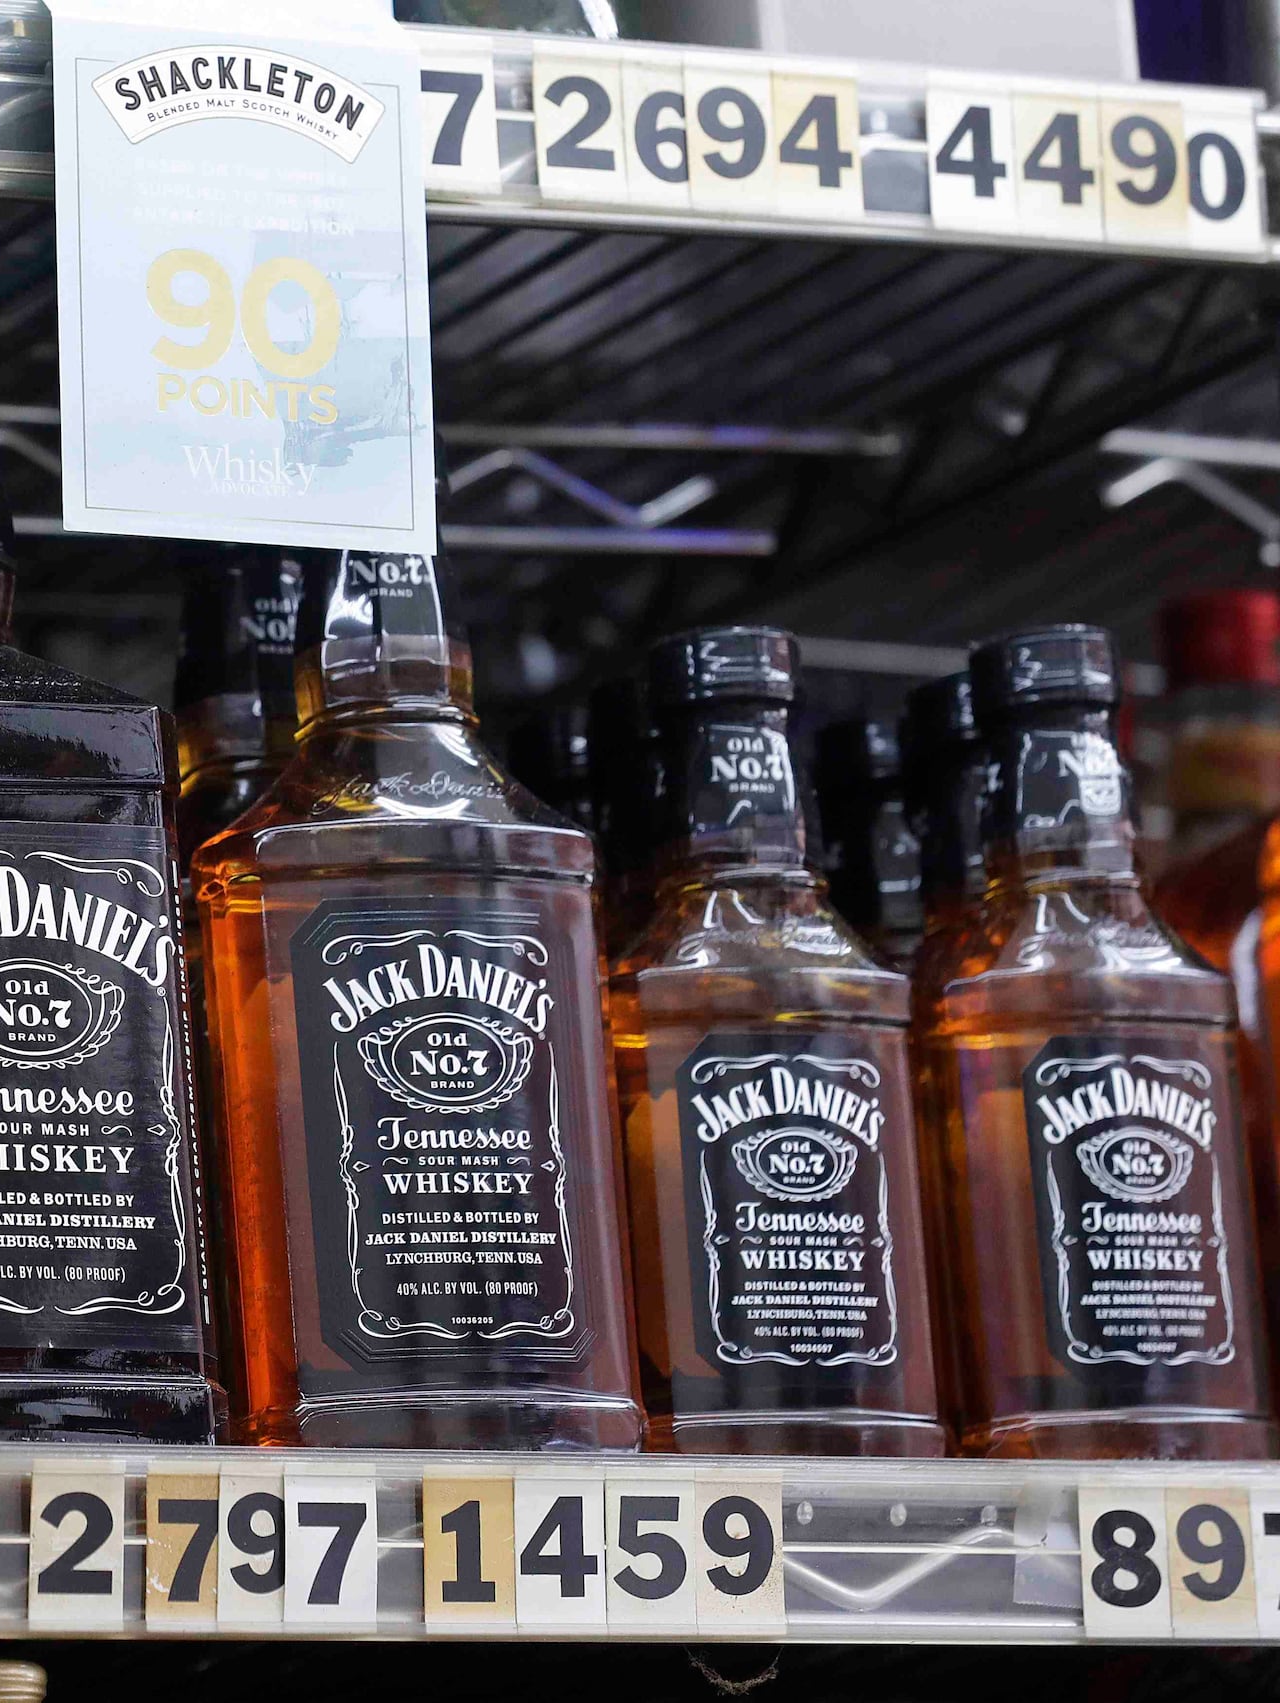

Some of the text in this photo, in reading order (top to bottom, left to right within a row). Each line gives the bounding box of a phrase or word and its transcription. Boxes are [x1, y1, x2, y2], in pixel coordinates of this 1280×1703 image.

[114, 55, 365, 132] SHACKLETON
[545, 73, 853, 189] 2694
[935, 106, 1246, 222] 4490
[145, 246, 342, 379] 90
[157, 373, 339, 425] POINTS
[180, 443, 317, 497] Whisky
[710, 754, 784, 783] No.7
[5, 979, 50, 996] Old
[322, 943, 556, 1033] JACK DANIEL'S
[8, 1032, 57, 1043] BRAND
[427, 1032, 469, 1047] Old
[409, 1049, 490, 1076] No.7
[430, 1080, 475, 1089] BRAND
[690, 1066, 886, 1147] JACK DANIEL'S
[1036, 1067, 1217, 1147] JACK DANIEL'S
[41, 1122, 90, 1137] MASH
[377, 1117, 533, 1150] Tennessee
[780, 1141, 811, 1154] Old
[418, 1156, 499, 1166] SOUR MASH
[768, 1154, 825, 1175] No.7
[1111, 1154, 1165, 1176] No.7
[382, 1172, 534, 1194] WHISKEY
[30, 1193, 41, 1205] &
[43, 1192, 112, 1207] BOTTLED
[116, 1194, 135, 1207] BY
[50, 1214, 156, 1230] DISTILLERY
[382, 1212, 540, 1224] DISTILLED & BOTTLED BY
[735, 1202, 866, 1233] Tennessee
[1081, 1202, 1203, 1234] Tennessee
[106, 1236, 138, 1251] USA
[365, 1232, 557, 1245] JACK DANIEL DISTILLERY
[769, 1236, 838, 1246] SOUR MASH
[740, 1250, 866, 1272] WHISKEY
[1086, 1250, 1204, 1272] WHISKEY
[20, 1265, 35, 1279] BY
[37, 1265, 61, 1280] VOL.
[64, 1265, 83, 1282] (80
[86, 1266, 127, 1283] PROOF)
[396, 1282, 538, 1297] 40% ALC. BY VOL. (80 PROOF)
[744, 1281, 798, 1291] DISTILLED
[731, 1295, 763, 1305] JACK
[765, 1295, 811, 1305] DANIEL
[451, 1316, 494, 1325] 10036205
[441, 1494, 776, 1603] 1459
[1091, 1503, 1280, 1611] 89
